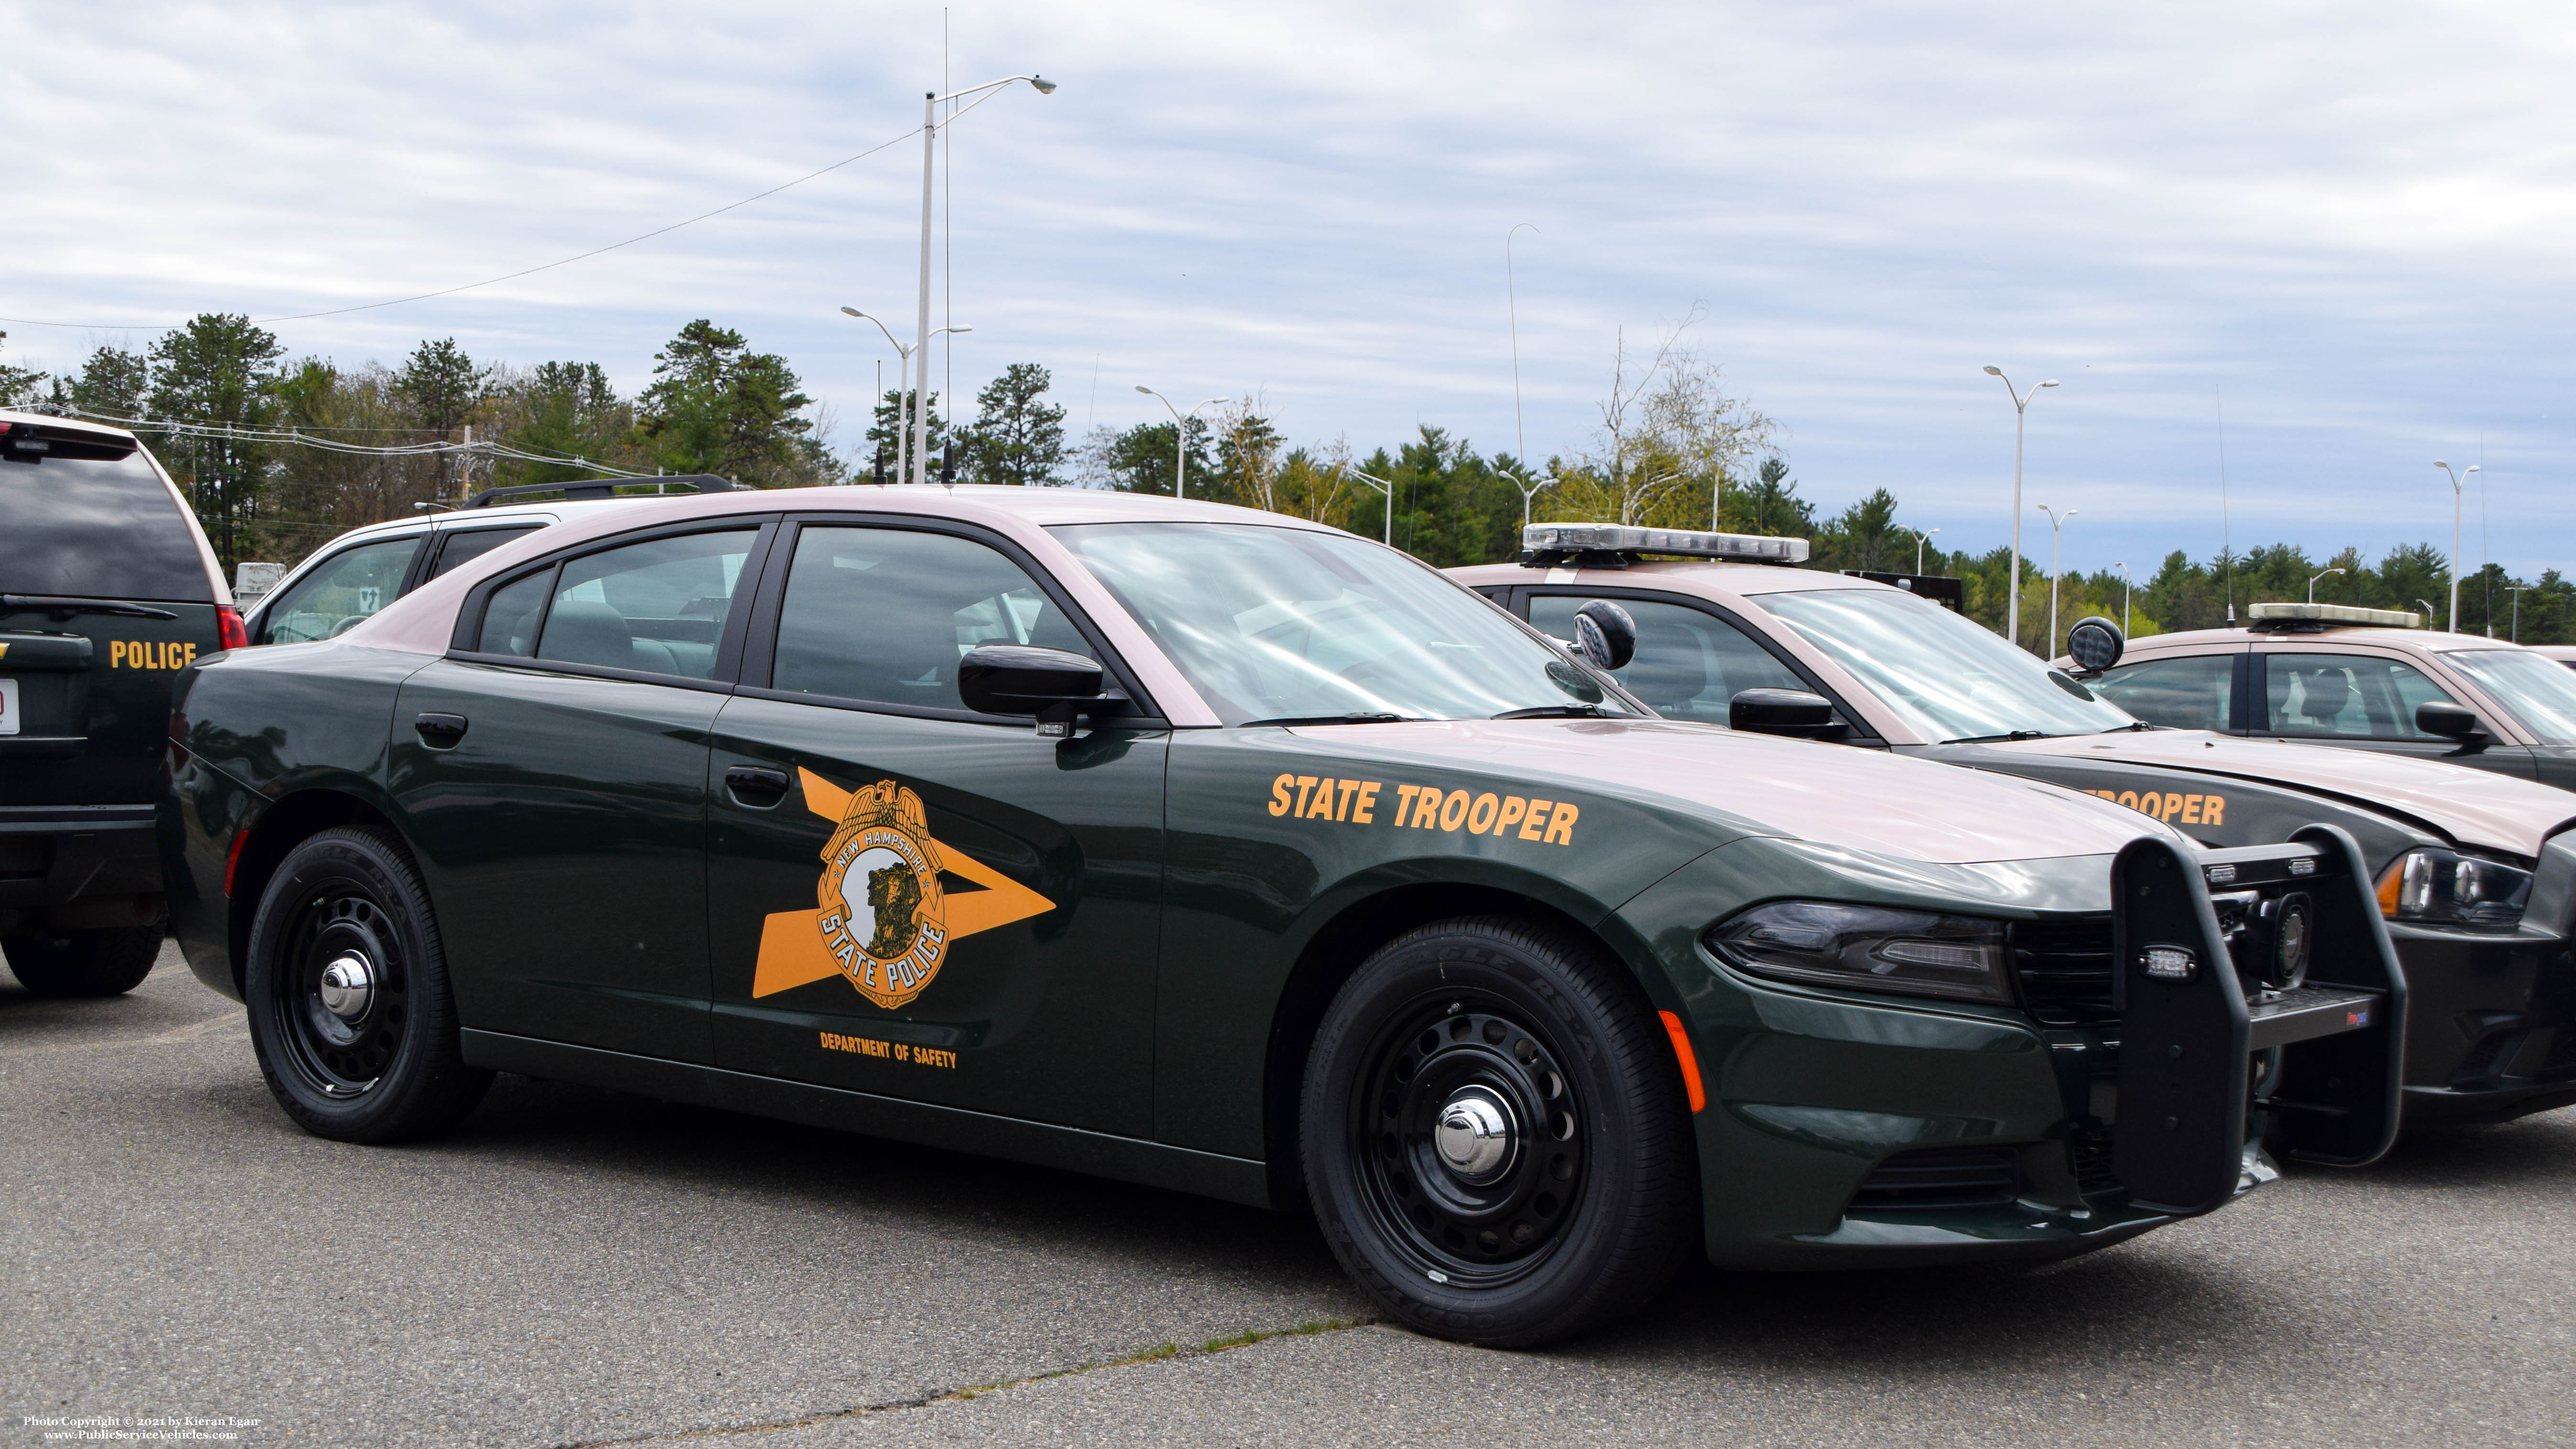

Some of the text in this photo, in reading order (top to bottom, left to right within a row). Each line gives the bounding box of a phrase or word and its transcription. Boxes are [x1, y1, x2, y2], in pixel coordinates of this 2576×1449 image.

[110, 641, 196, 670] POLICE
[1268, 773, 1579, 846] STATE TROOPER
[2083, 789, 2225, 825] OOPER
[836, 831, 927, 876] NEW HAMPSHIRE
[821, 913, 944, 991] STATE POLICE
[820, 1032, 956, 1069] DEPARTMENT OF SAFETY
